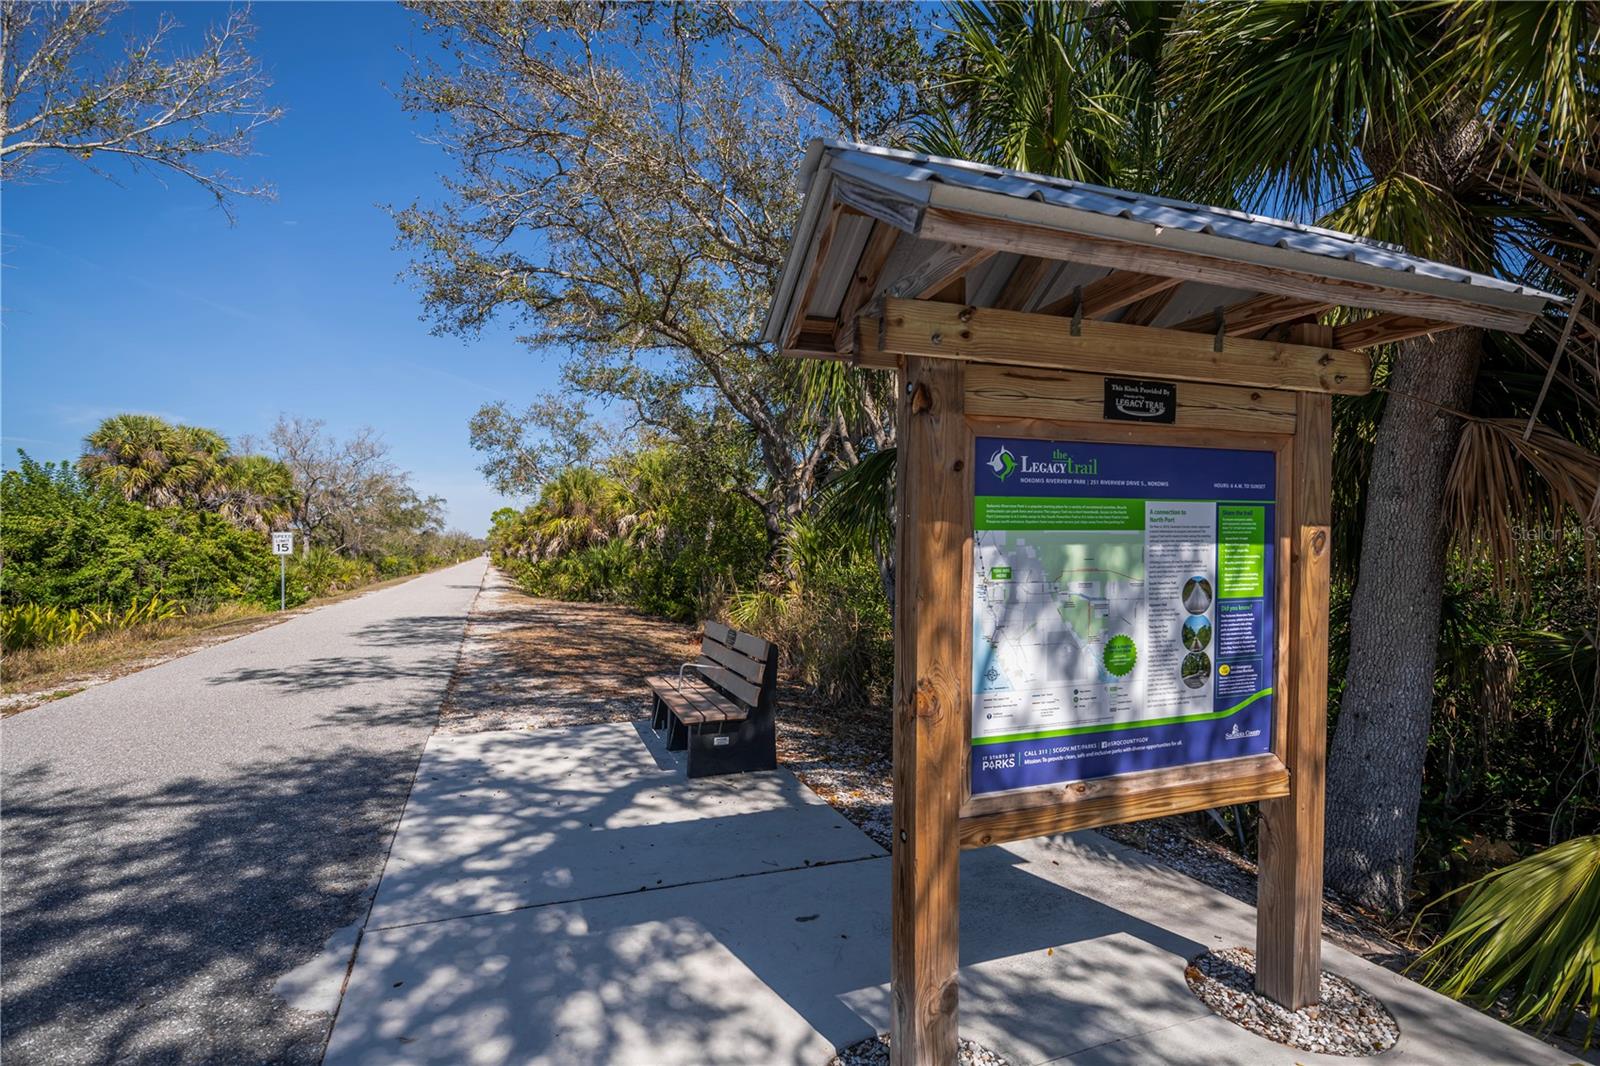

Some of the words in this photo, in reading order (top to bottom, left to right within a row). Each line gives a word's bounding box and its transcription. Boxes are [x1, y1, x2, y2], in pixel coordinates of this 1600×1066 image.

[1124, 385, 1139, 393] Kiosk
[1139, 387, 1162, 395] Provided
[1163, 389, 1170, 397] By
[1115, 398, 1144, 408] LEGACY
[1145, 401, 1166, 410] TRAIL
[1053, 449, 1068, 460] the
[1020, 455, 1067, 474] LEGACY
[1067, 457, 1097, 475] trail
[276, 543, 289, 552] 15
[1048, 756, 1064, 764] provide
[1145, 742, 1171, 751] opportunities
[982, 758, 1016, 771] PARKS
